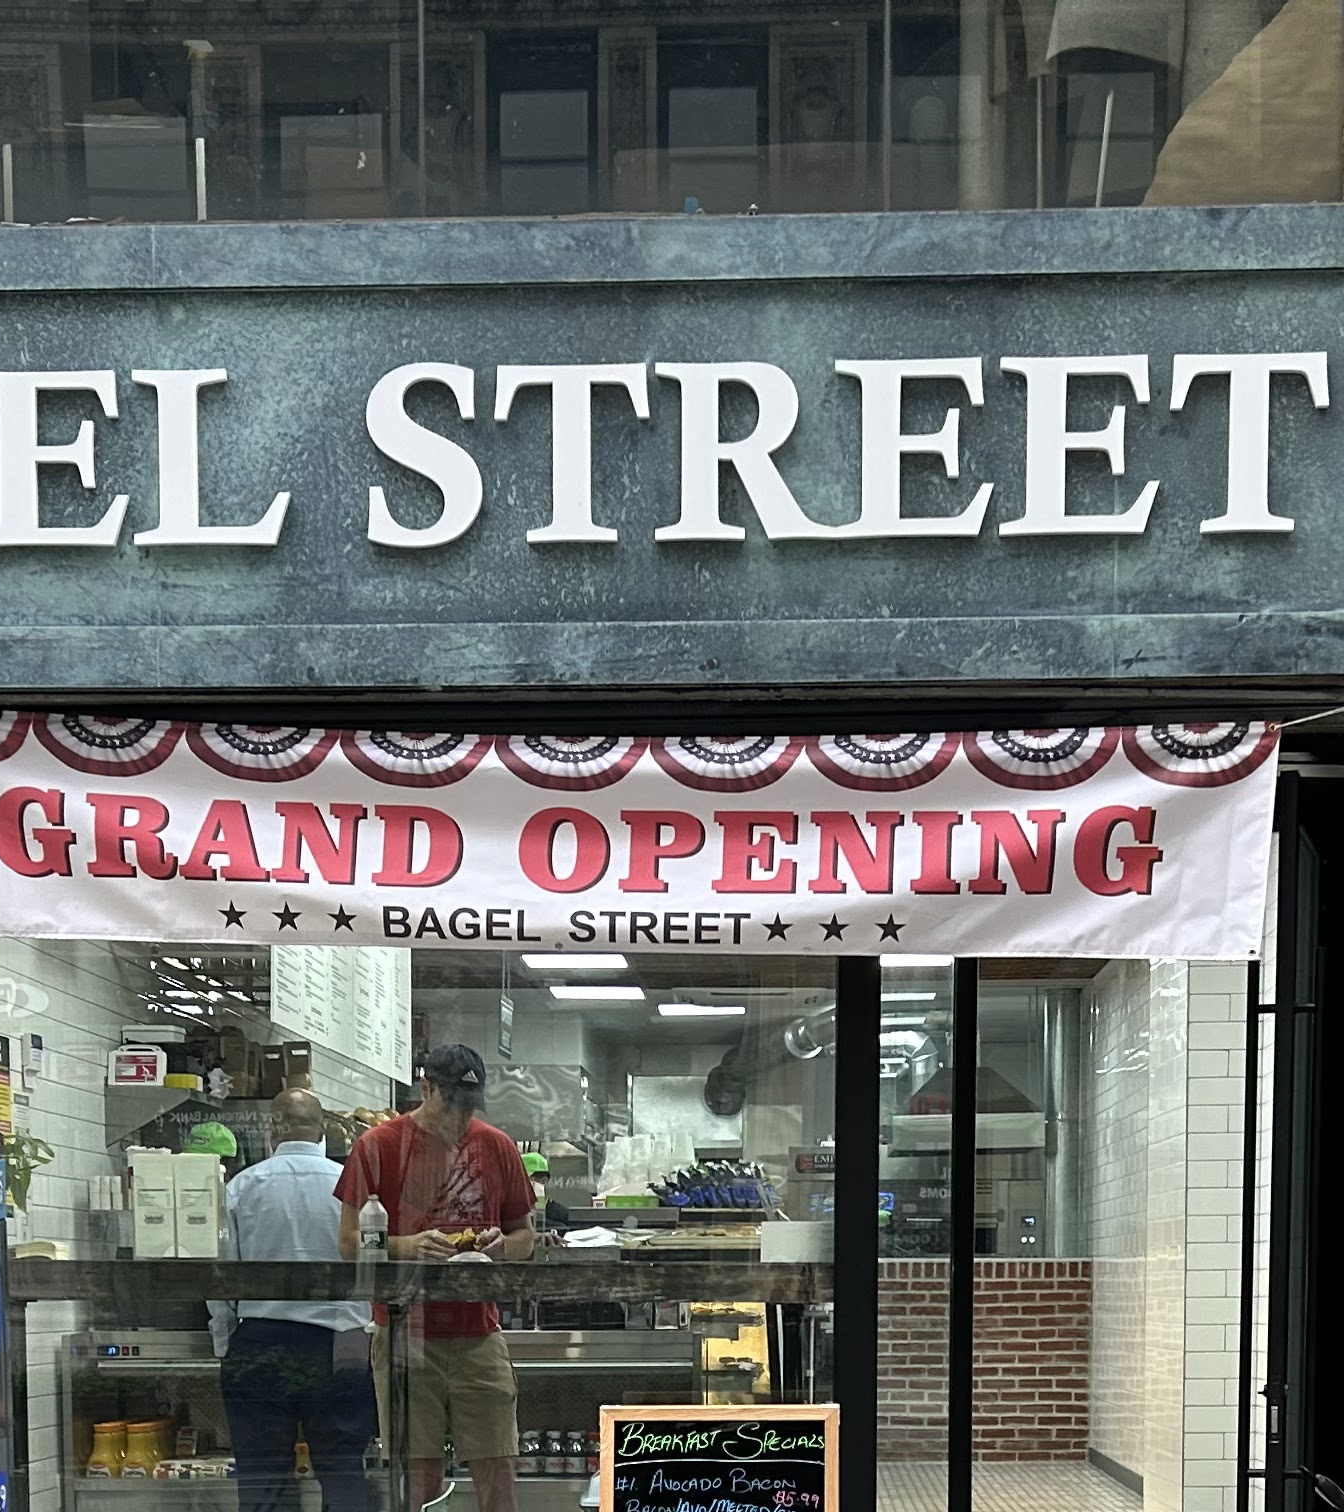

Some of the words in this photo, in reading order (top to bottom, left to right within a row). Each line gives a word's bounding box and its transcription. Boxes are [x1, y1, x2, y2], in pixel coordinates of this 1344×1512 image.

[365, 352, 1330, 549] STREET
[518, 805, 1163, 897] OPENING
[382, 906, 541, 942] BAGEL
[568, 910, 752, 945] STREET
[618, 1422, 722, 1457] BREAKFAST
[723, 1422, 825, 1459] SPECIALS
[649, 1469, 722, 1494] AVOCADO
[730, 1468, 796, 1493] BACON
